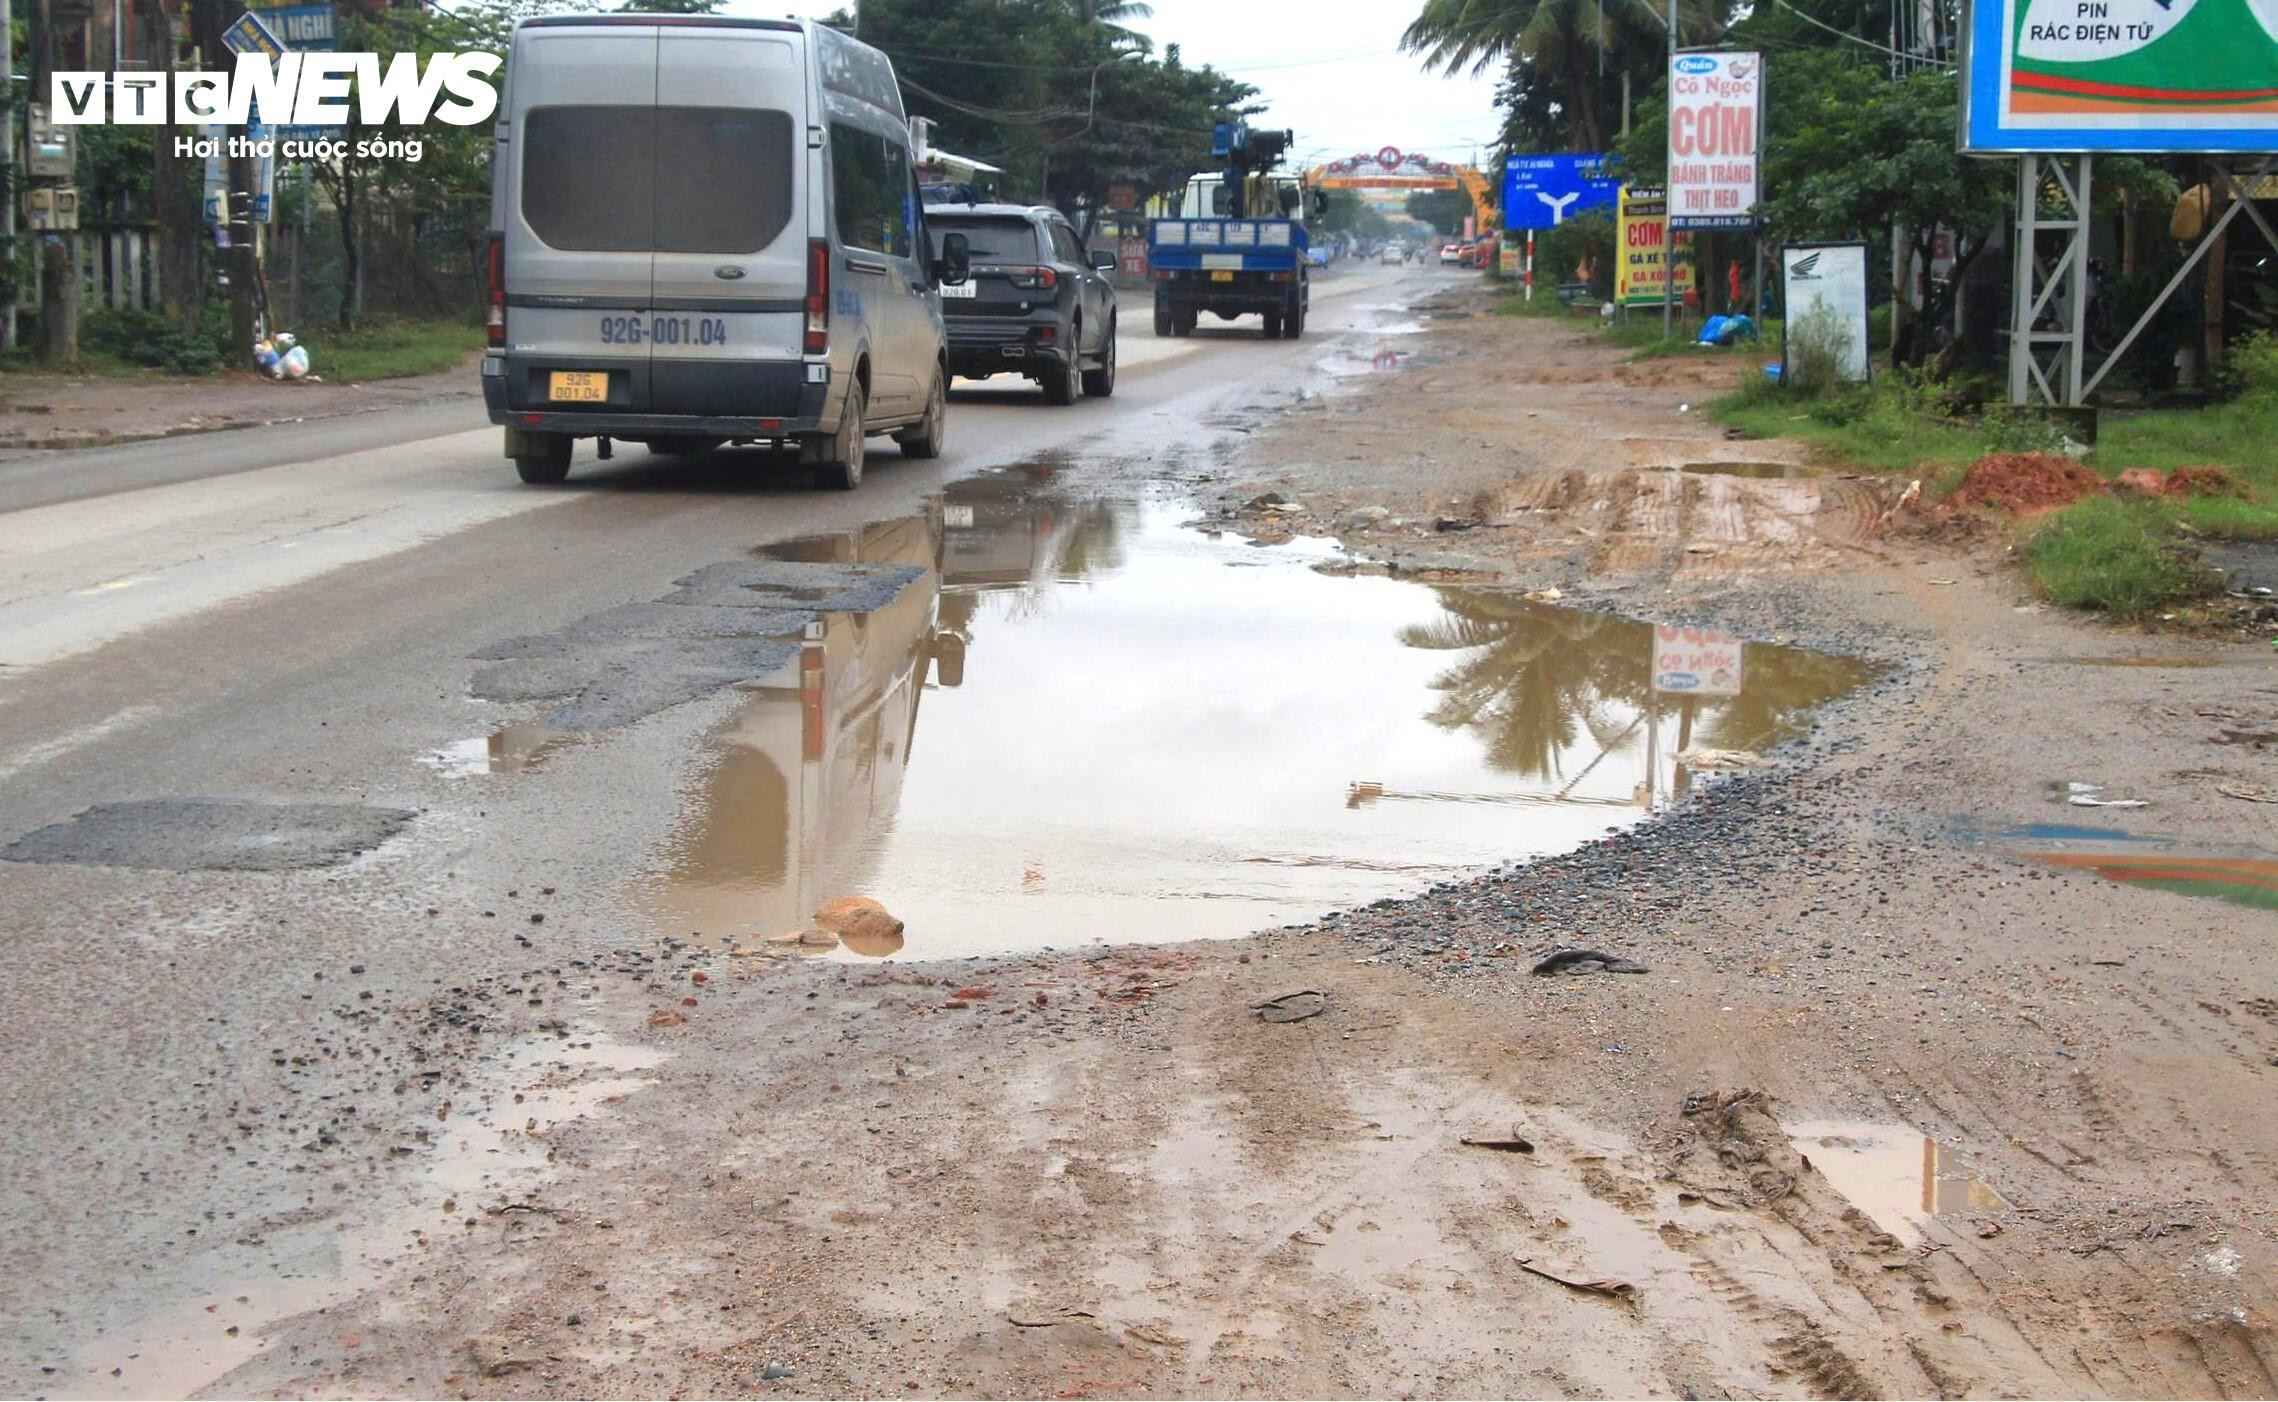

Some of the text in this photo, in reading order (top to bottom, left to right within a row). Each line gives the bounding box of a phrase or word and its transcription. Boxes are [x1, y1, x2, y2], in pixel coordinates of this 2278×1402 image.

[2077, 3, 2107, 18] PIN
[2031, 22, 2153, 43] RÁC ĐIỆN TỬ
[1675, 77, 1752, 98] Cô Ngọc
[1672, 102, 1753, 157] CƠM
[1672, 160, 1752, 184] BÁNH TRÁNG
[1684, 189, 1709, 212] THỊT
[1714, 189, 1739, 209] HEO
[1628, 220, 1663, 247] CƠM
[1125, 259, 1140, 273] XE
